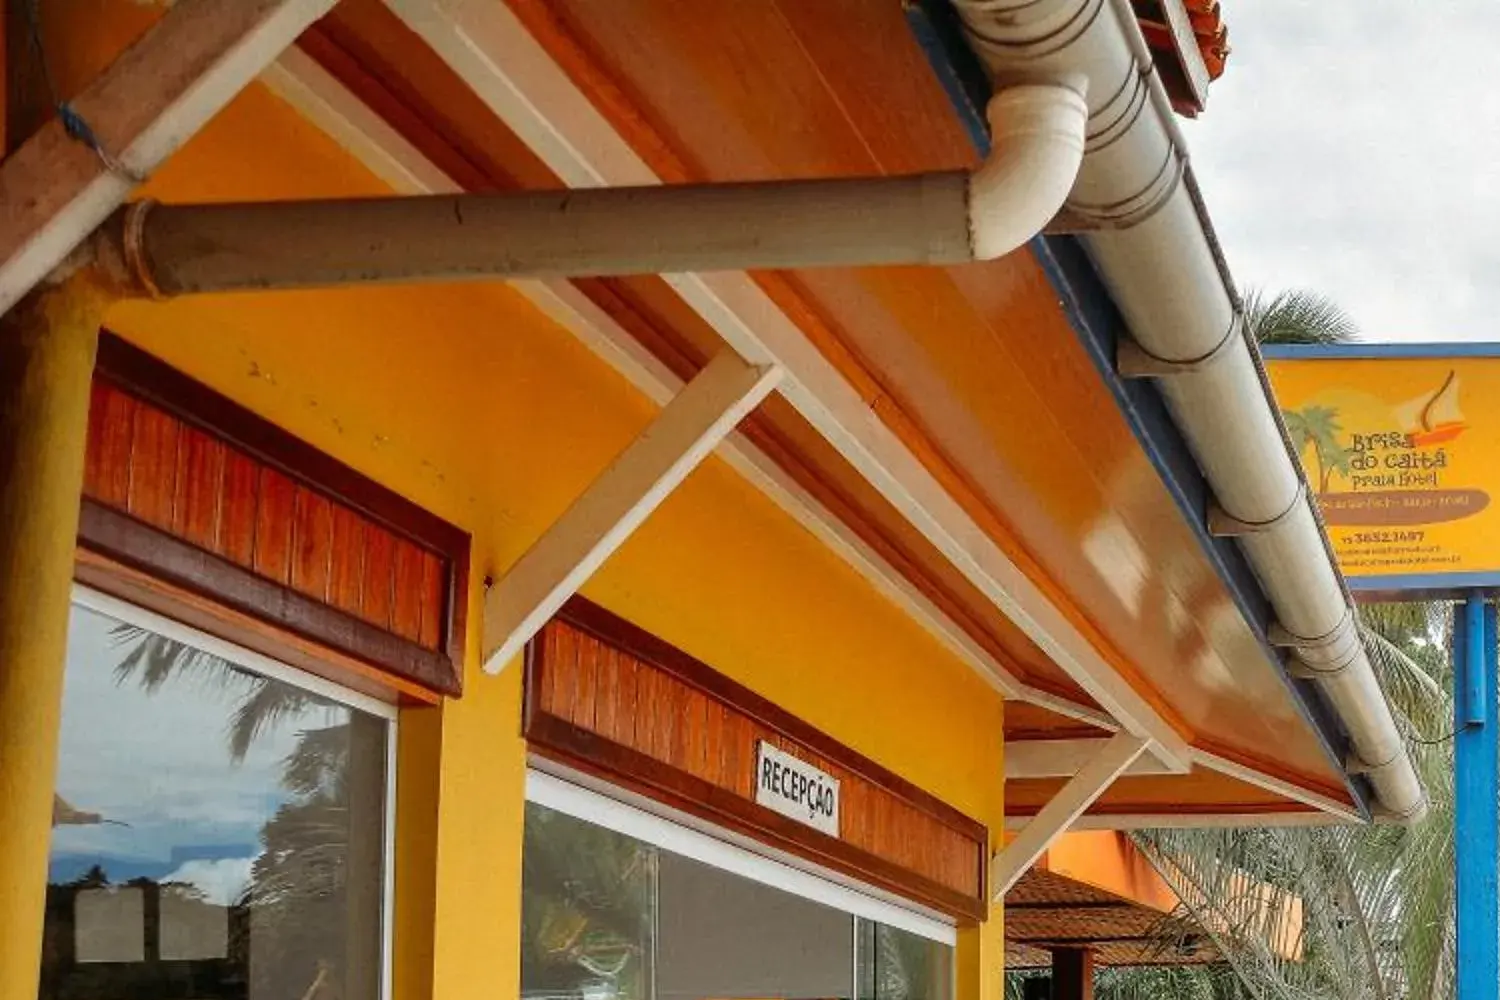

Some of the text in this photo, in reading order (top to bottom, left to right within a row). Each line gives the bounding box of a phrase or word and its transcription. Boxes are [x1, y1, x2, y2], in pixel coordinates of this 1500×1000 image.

[1349, 431, 1416, 453] Brisa
[1351, 450, 1378, 470] do
[761, 757, 835, 819] RECEPÇÃO
